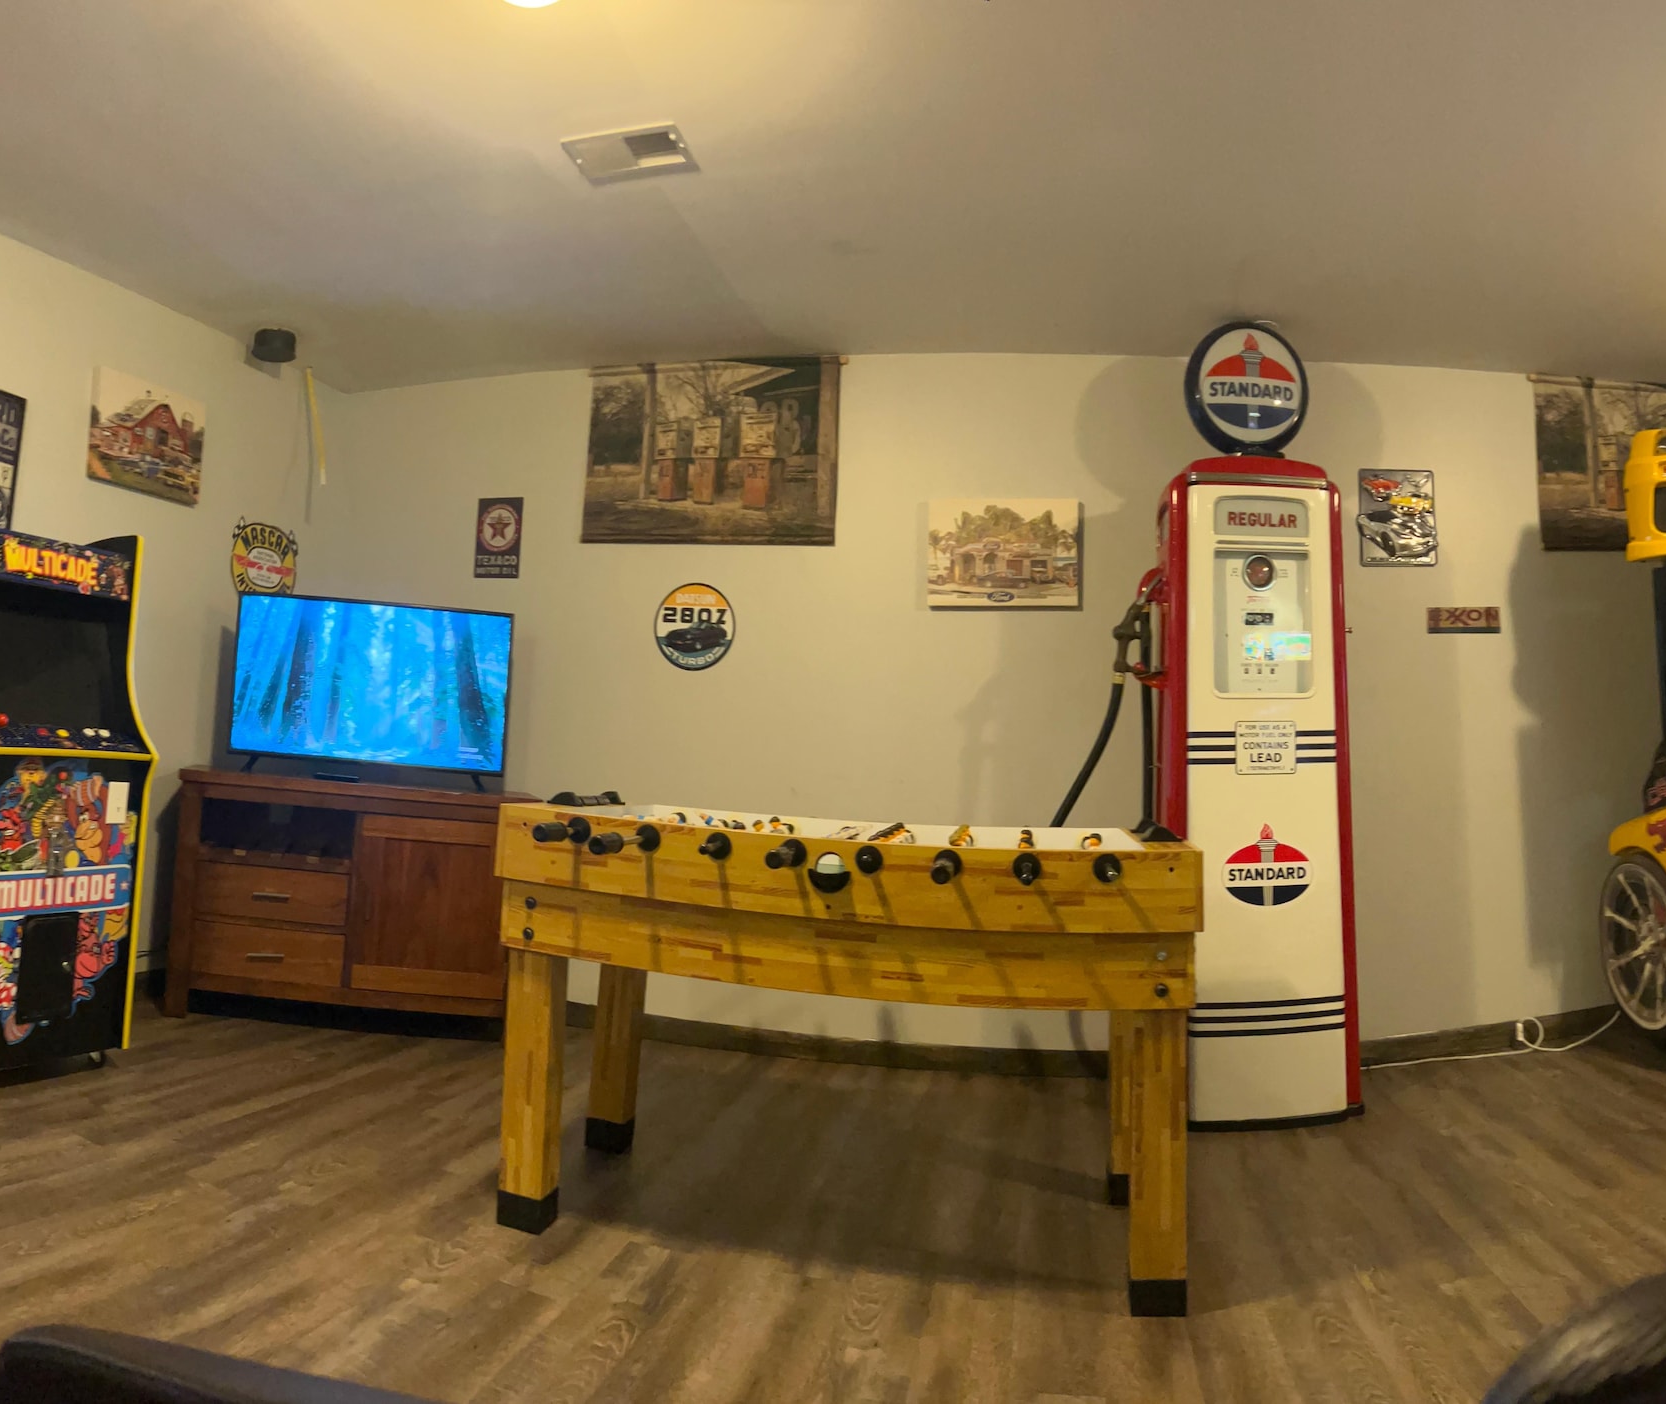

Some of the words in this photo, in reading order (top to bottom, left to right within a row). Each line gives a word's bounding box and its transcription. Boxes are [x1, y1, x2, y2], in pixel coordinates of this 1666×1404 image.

[1209, 381, 1293, 401] STANDARD
[1227, 511, 1297, 528] REGULAR
[241, 527, 290, 562] NASCAR
[3, 541, 99, 586] MULTICADE
[476, 555, 517, 566] TEXACO
[662, 606, 728, 625] 280Z
[1428, 607, 1499, 627] EXXON
[671, 650, 715, 665] TURBO
[1243, 742, 1289, 750] CONTAINS
[1250, 752, 1282, 763] LEAD
[1228, 866, 1307, 881] STANDARD
